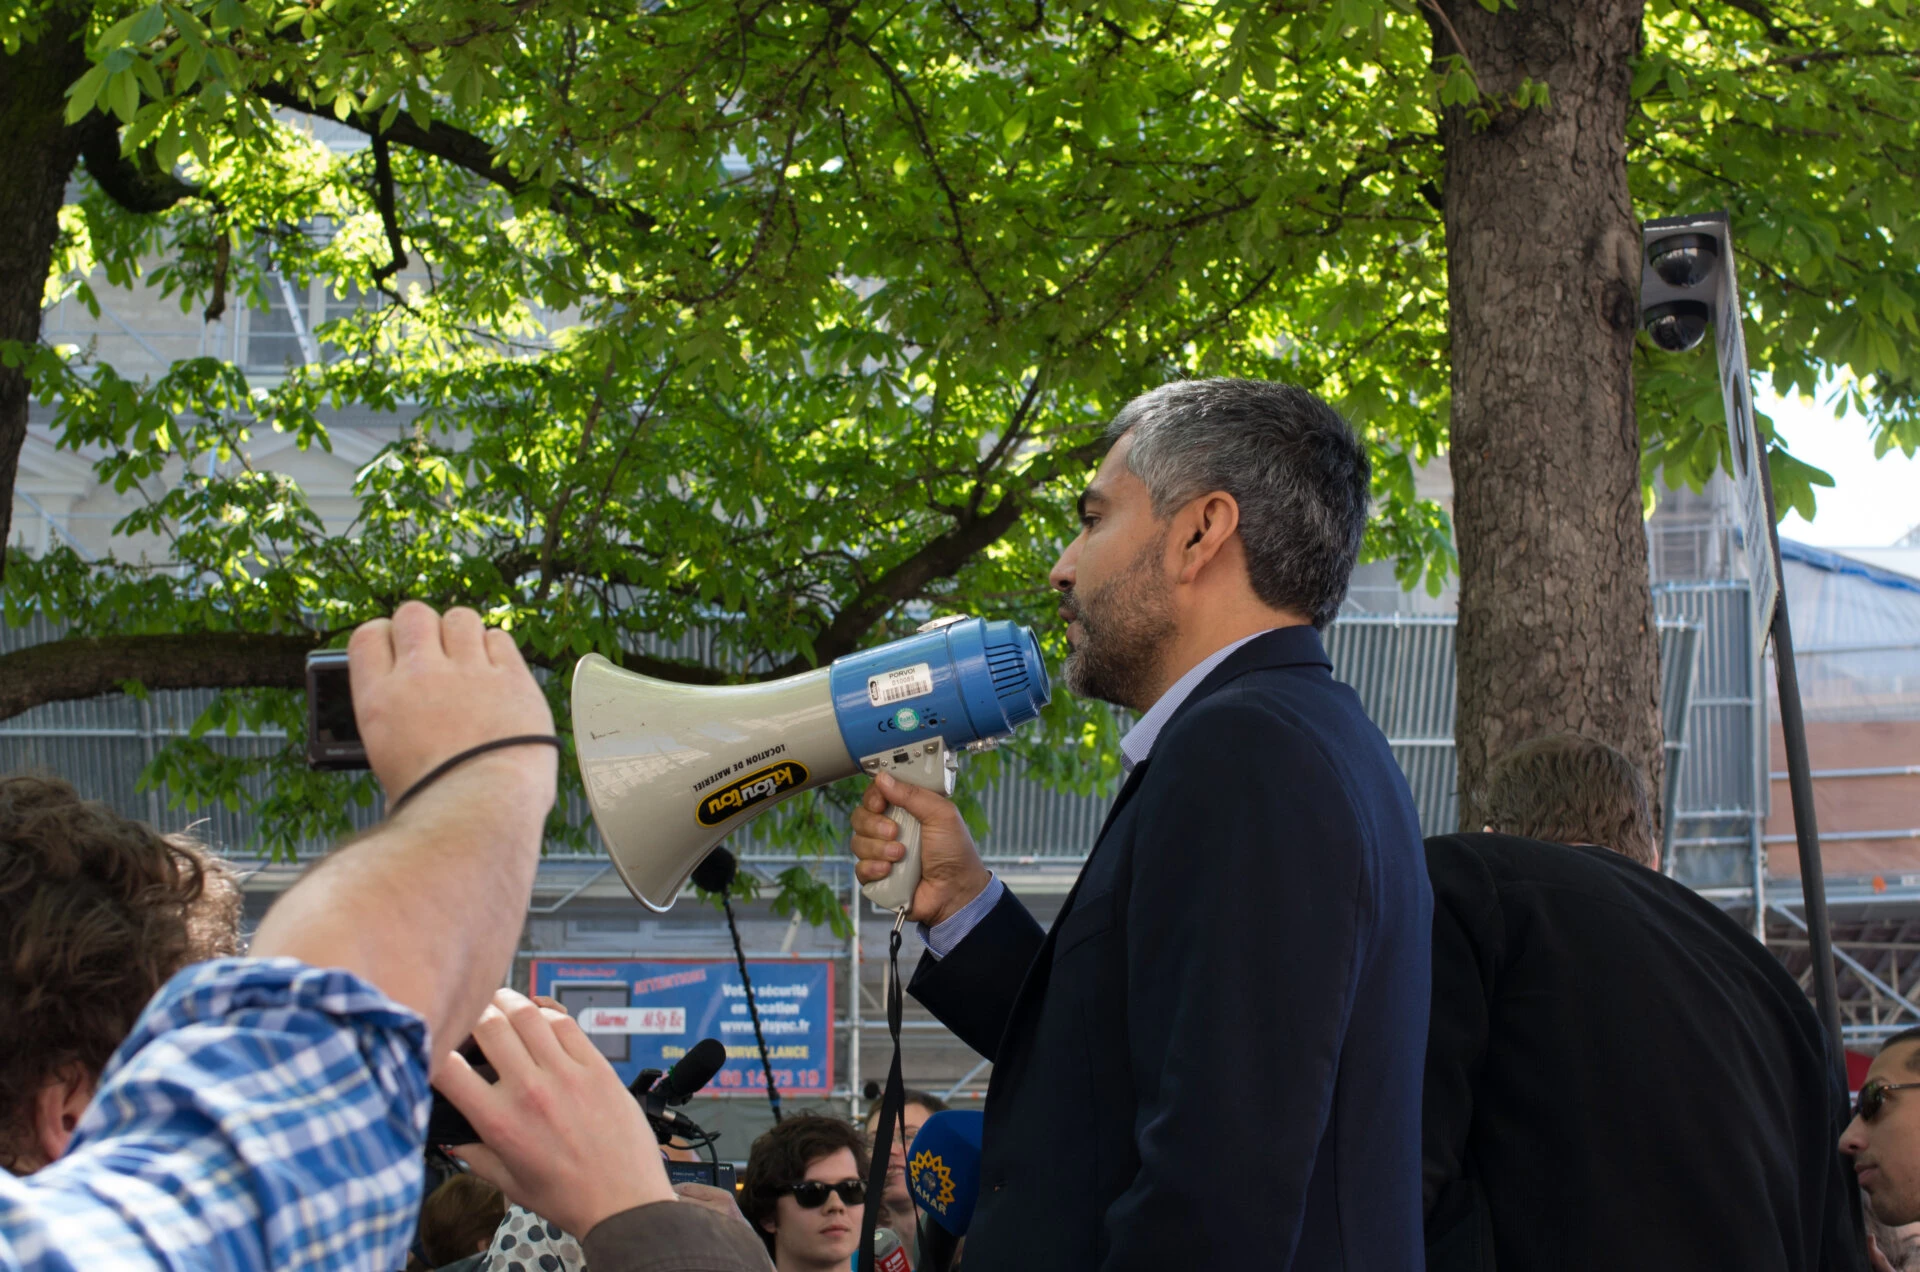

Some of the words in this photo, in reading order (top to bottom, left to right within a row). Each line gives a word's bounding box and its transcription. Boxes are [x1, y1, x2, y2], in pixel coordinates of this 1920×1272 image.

[888, 668, 916, 680] PORVOI
[745, 743, 786, 766] LOCATION
[733, 761, 744, 772] DE
[693, 766, 731, 792] MATERIEL
[757, 983, 809, 998] sécurité
[730, 1003, 748, 1015] en
[752, 1000, 800, 1015] ocation
[661, 1045, 686, 1060] Site
[772, 1069, 793, 1087] 73
